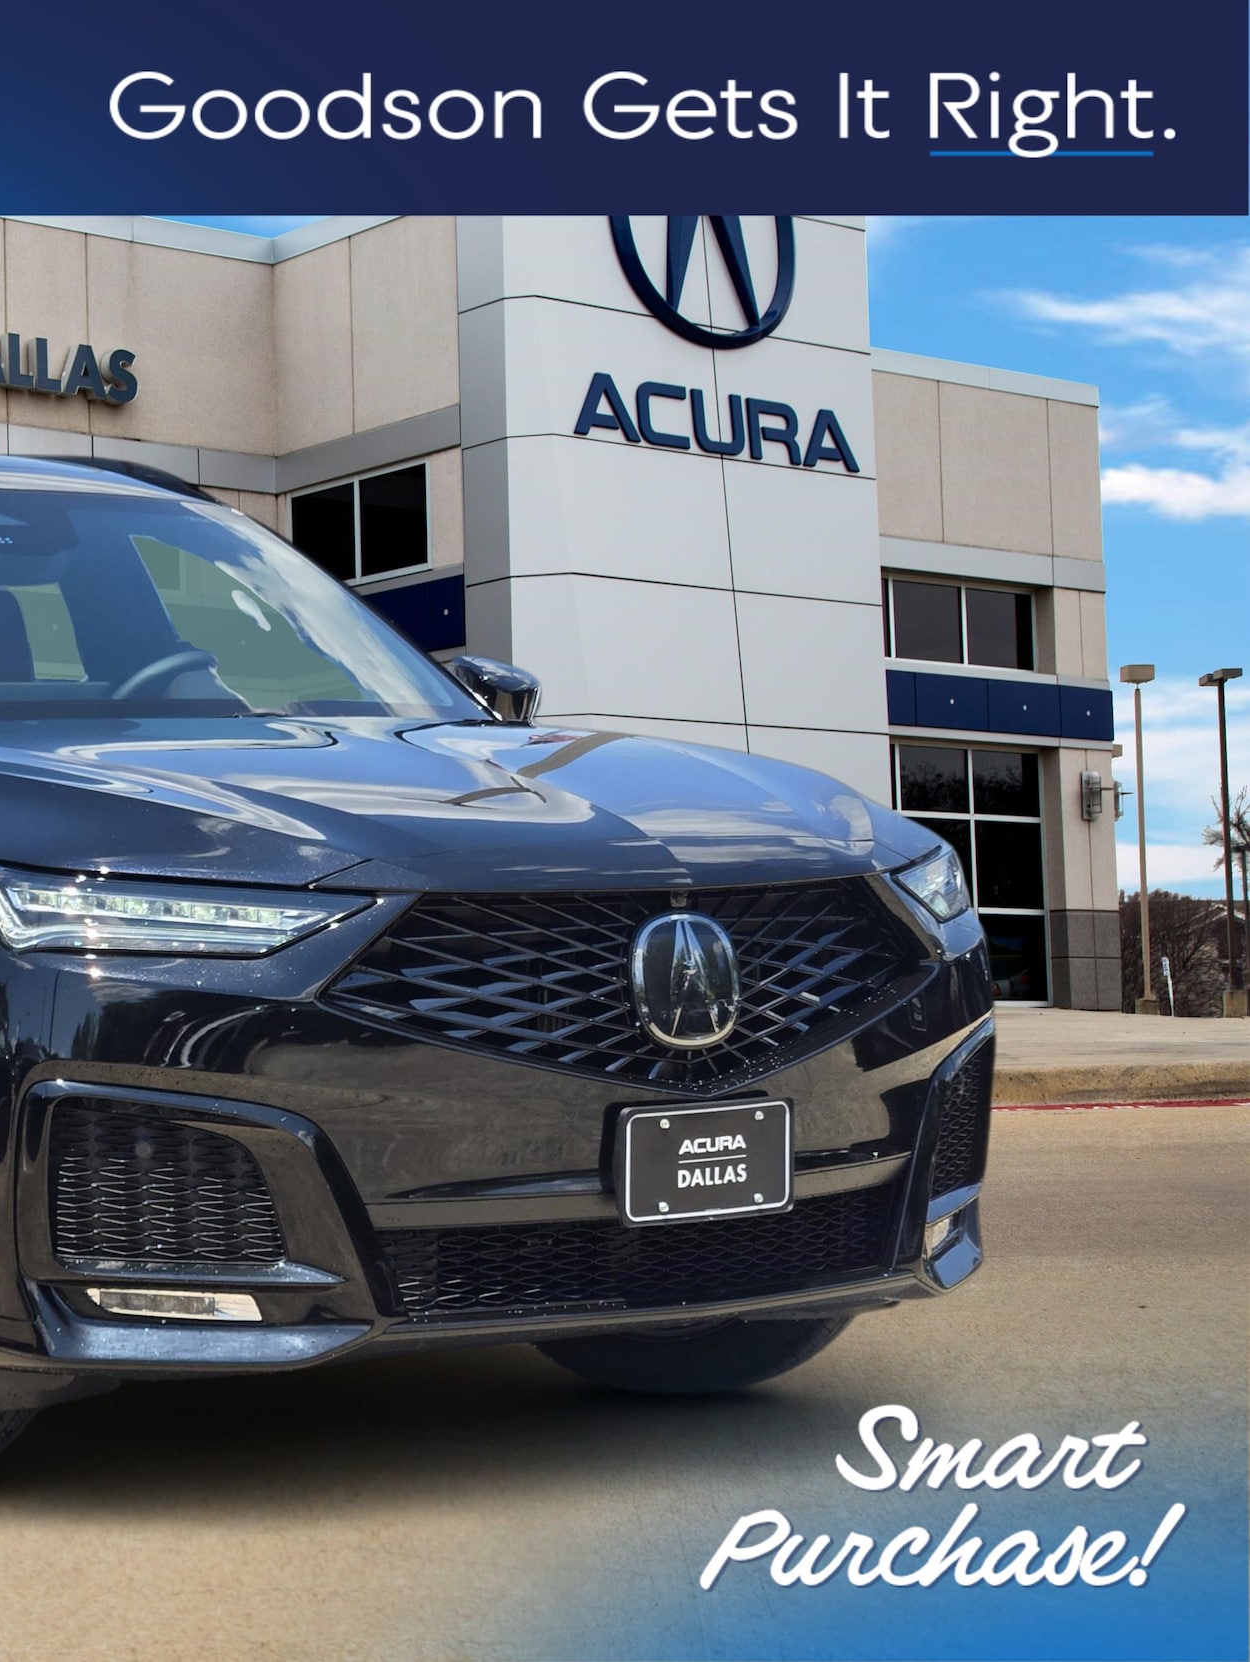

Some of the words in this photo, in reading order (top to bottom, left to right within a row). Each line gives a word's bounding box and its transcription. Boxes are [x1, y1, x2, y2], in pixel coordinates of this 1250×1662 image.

[573, 372, 860, 473] ACURA
[678, 1134, 747, 1155] ACURA
[677, 1163, 747, 1189] DALLAS
